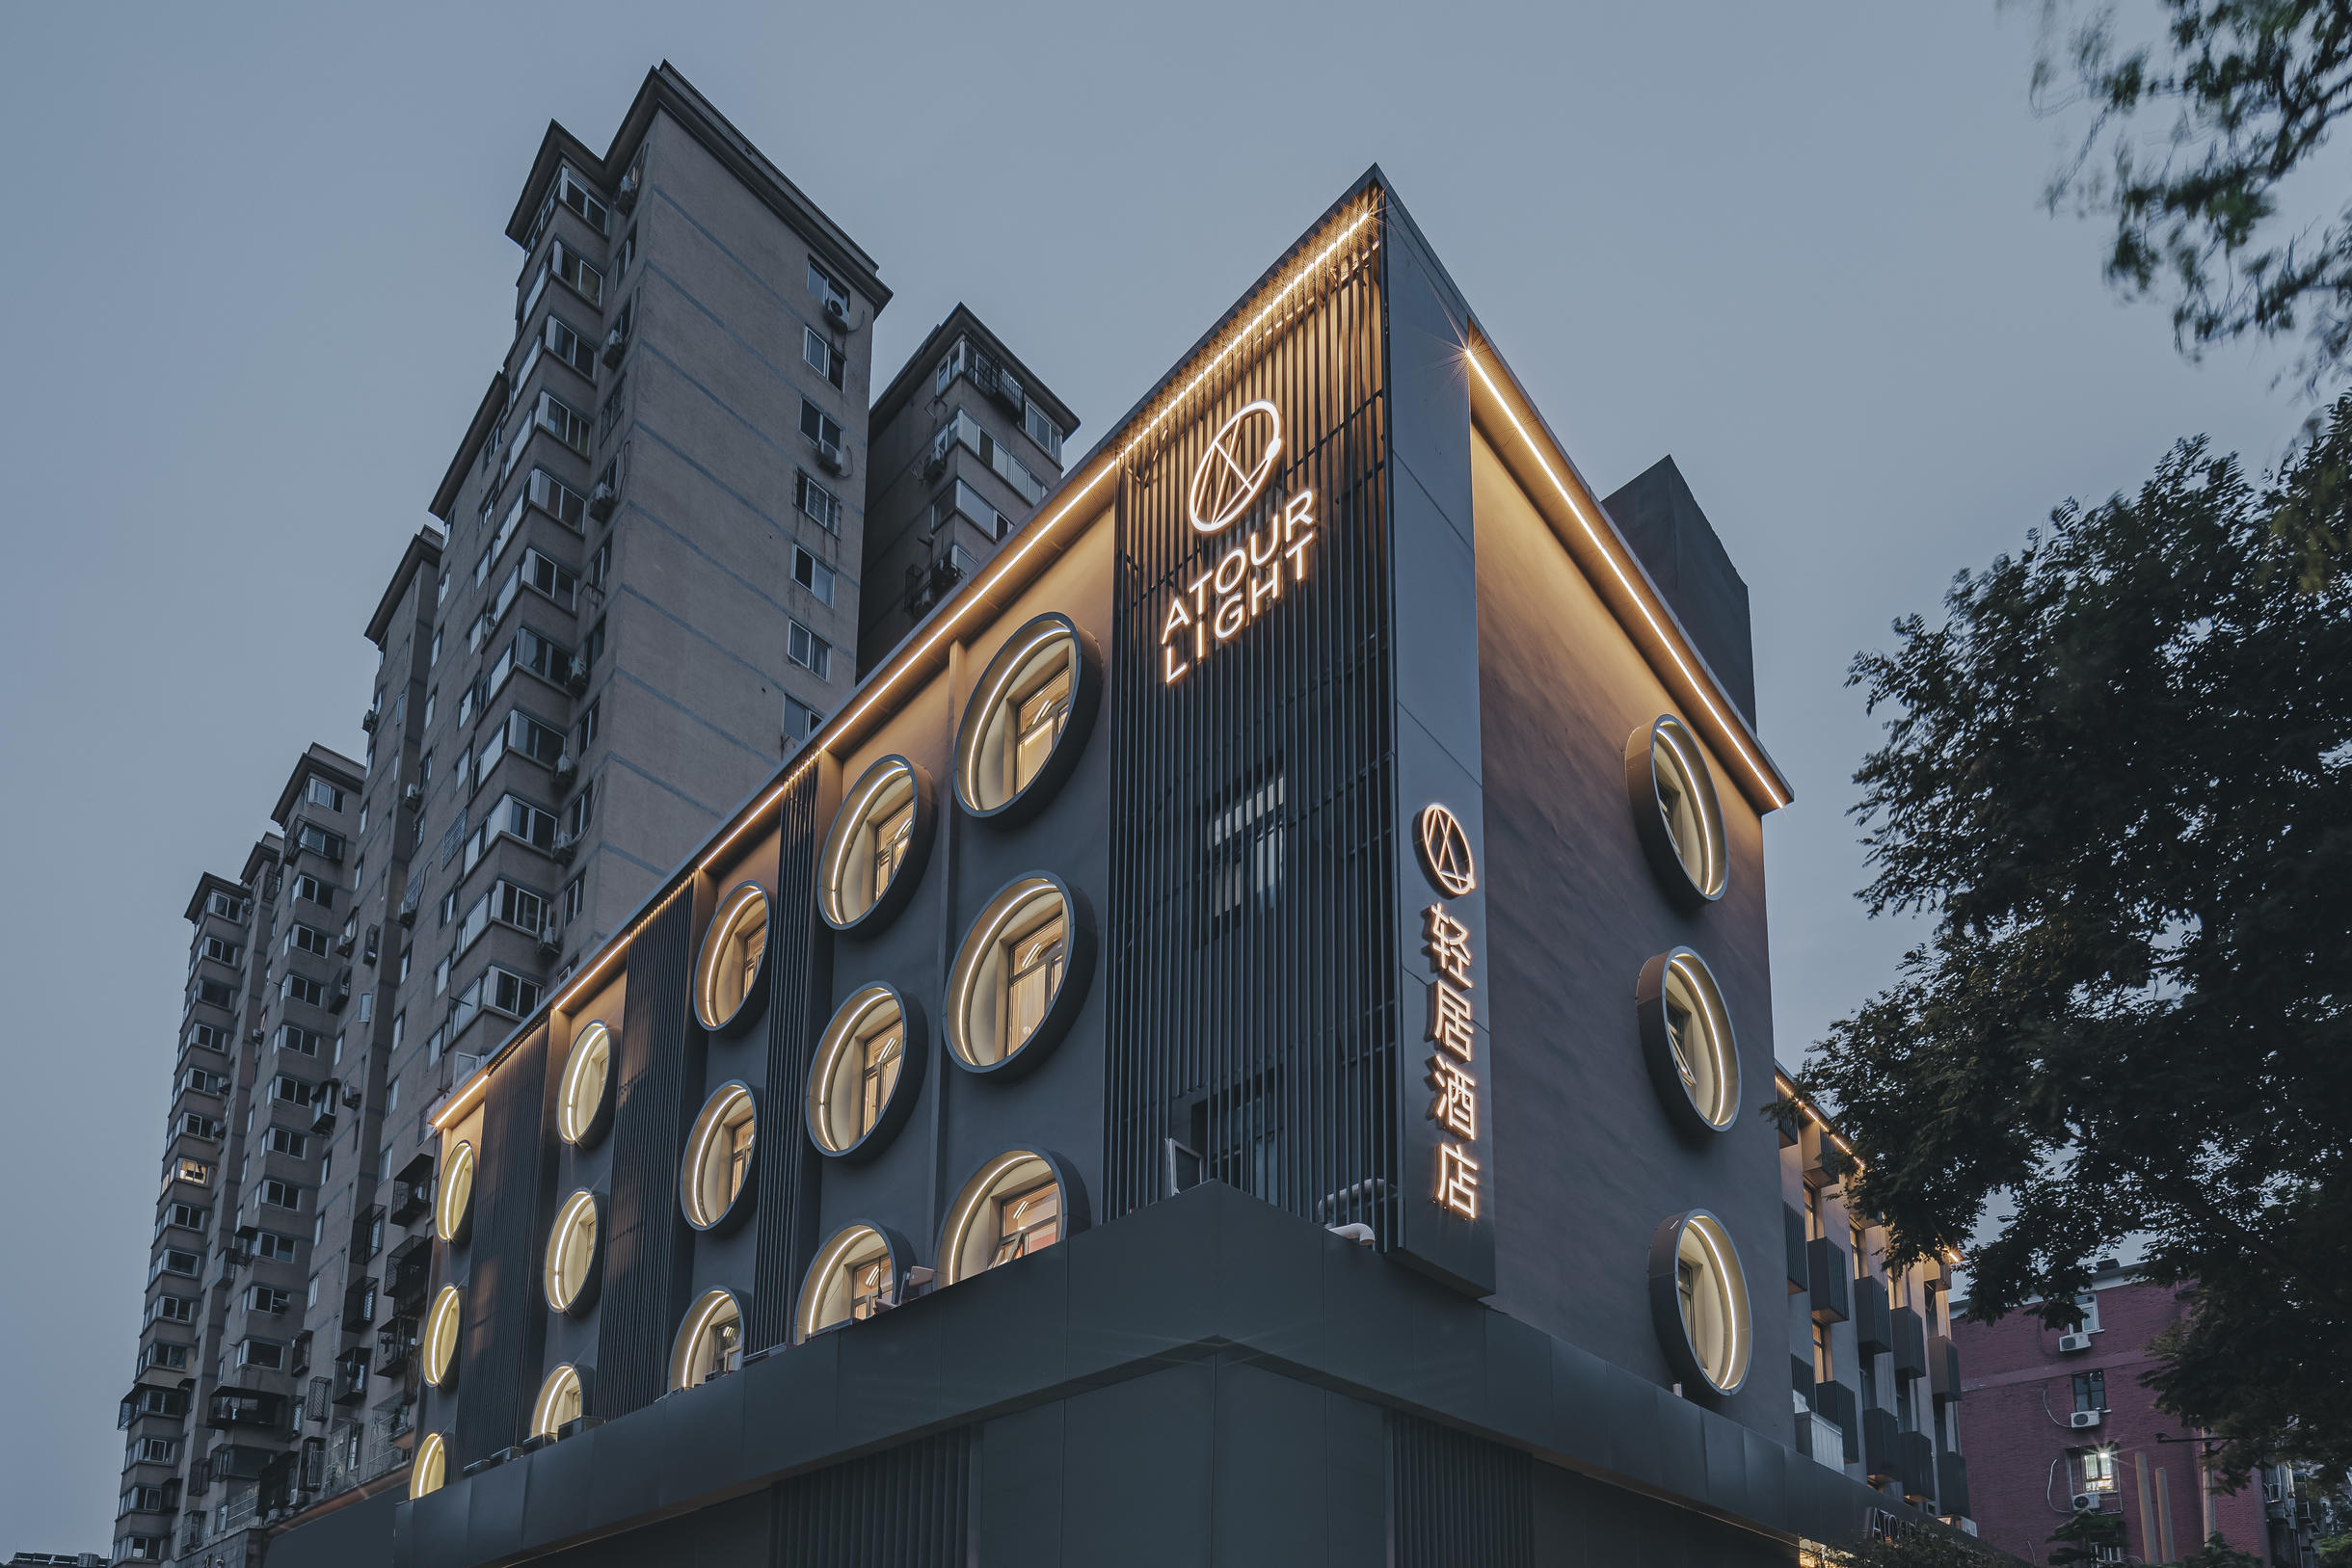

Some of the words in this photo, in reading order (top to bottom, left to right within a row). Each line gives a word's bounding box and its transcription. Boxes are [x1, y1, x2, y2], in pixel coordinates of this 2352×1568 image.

[1161, 489, 1315, 646] ATOUR
[1164, 532, 1315, 684] LIGHT
[1428, 902, 1479, 1220] 轻居酒店
